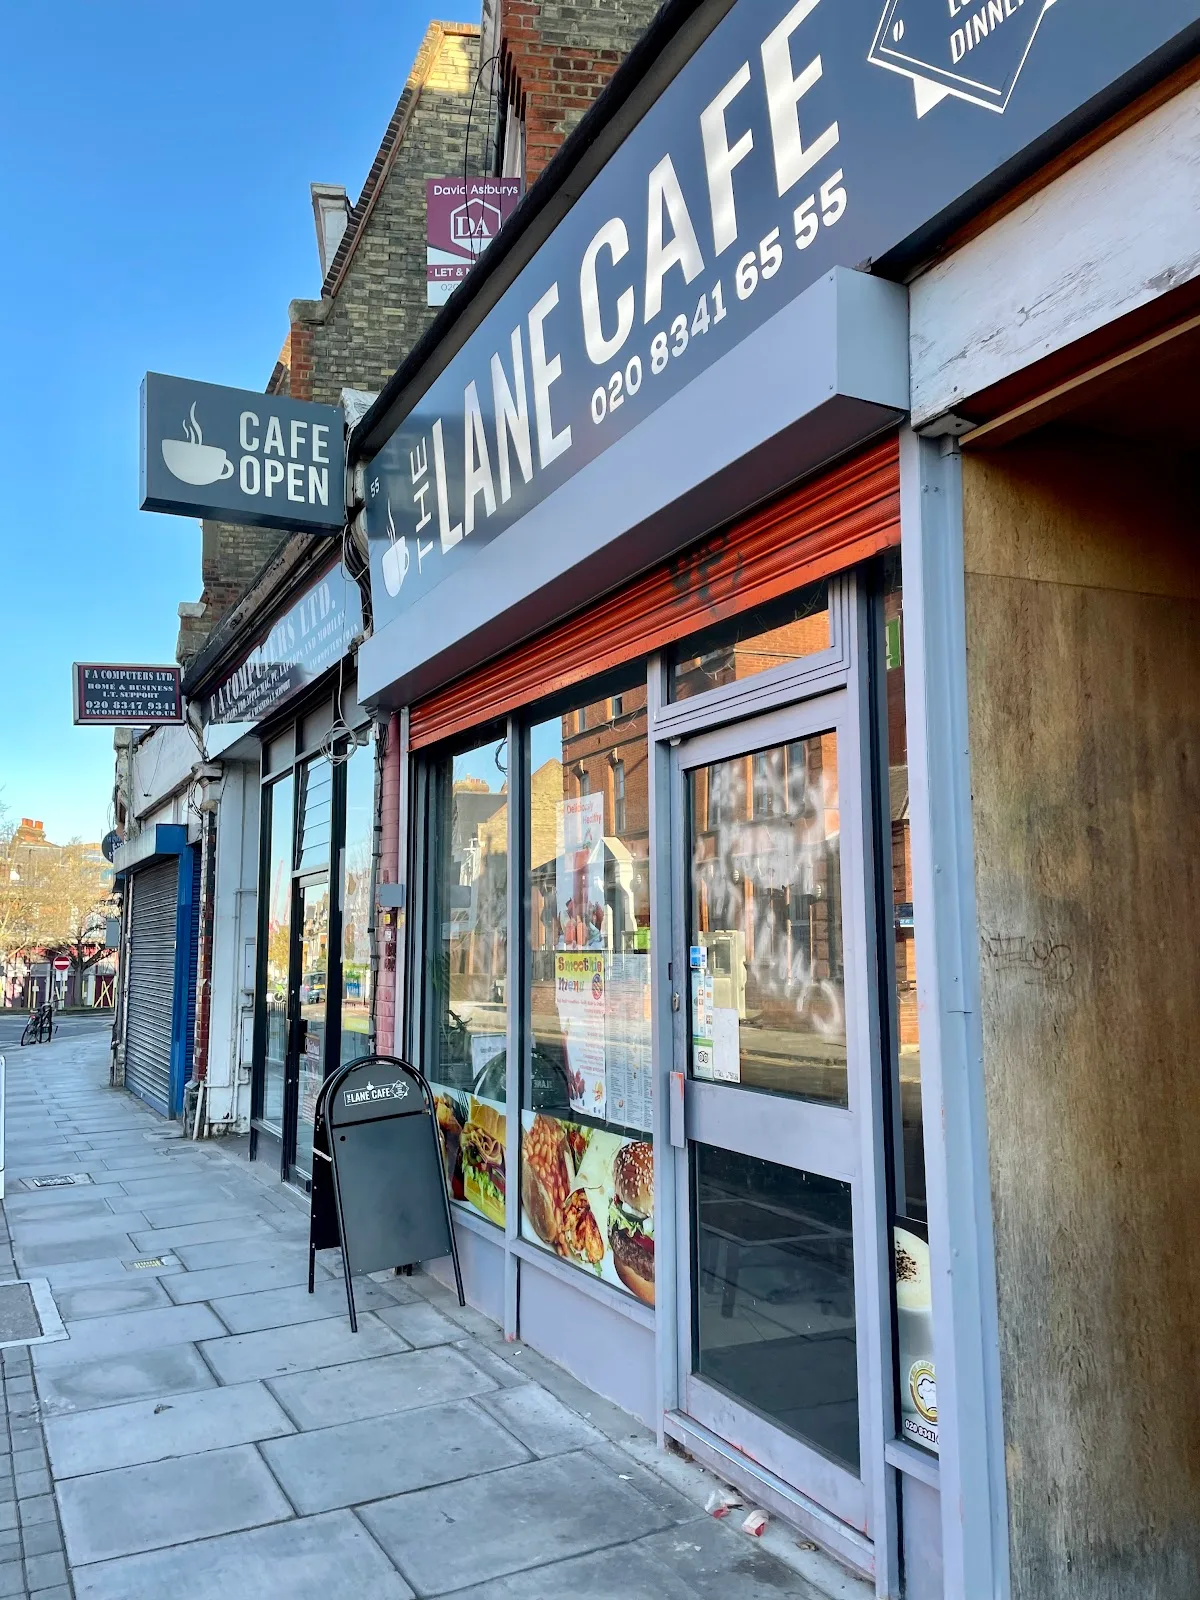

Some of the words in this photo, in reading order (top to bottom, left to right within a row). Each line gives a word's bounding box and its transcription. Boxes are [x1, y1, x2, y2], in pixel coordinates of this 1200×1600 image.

[950, 0, 1024, 65] DINNE
[433, 184, 468, 196] David
[455, 216, 492, 237] DA
[434, 268, 454, 277] LET
[455, 268, 464, 277] &
[410, 436, 434, 575] THE
[432, 281, 573, 555] LANE
[579, 0, 841, 366] CAFE
[591, 356, 643, 425] 020
[650, 280, 727, 375] 8341
[735, 226, 783, 301] 65
[793, 167, 848, 250] 55
[239, 411, 330, 464] CAFE
[239, 455, 329, 506] OPEN
[370, 476, 380, 498] 55
[300, 582, 336, 638] LTD.
[84, 669, 91, 679] F
[92, 669, 99, 679] A
[101, 670, 154, 681] COMPUTERS
[156, 672, 175, 682] LTD.
[118, 683, 126, 691] &
[128, 684, 174, 692] BUSINESS
[85, 700, 109, 709] 020
[112, 701, 142, 710] 8347
[147, 702, 176, 710] 9341
[558, 956, 602, 973] Smoothie
[351, 1090, 371, 1103] LANE
[371, 1087, 391, 1100] CAFE
[905, 1419, 918, 1433] 020
[918, 1426, 936, 1443] 8341
